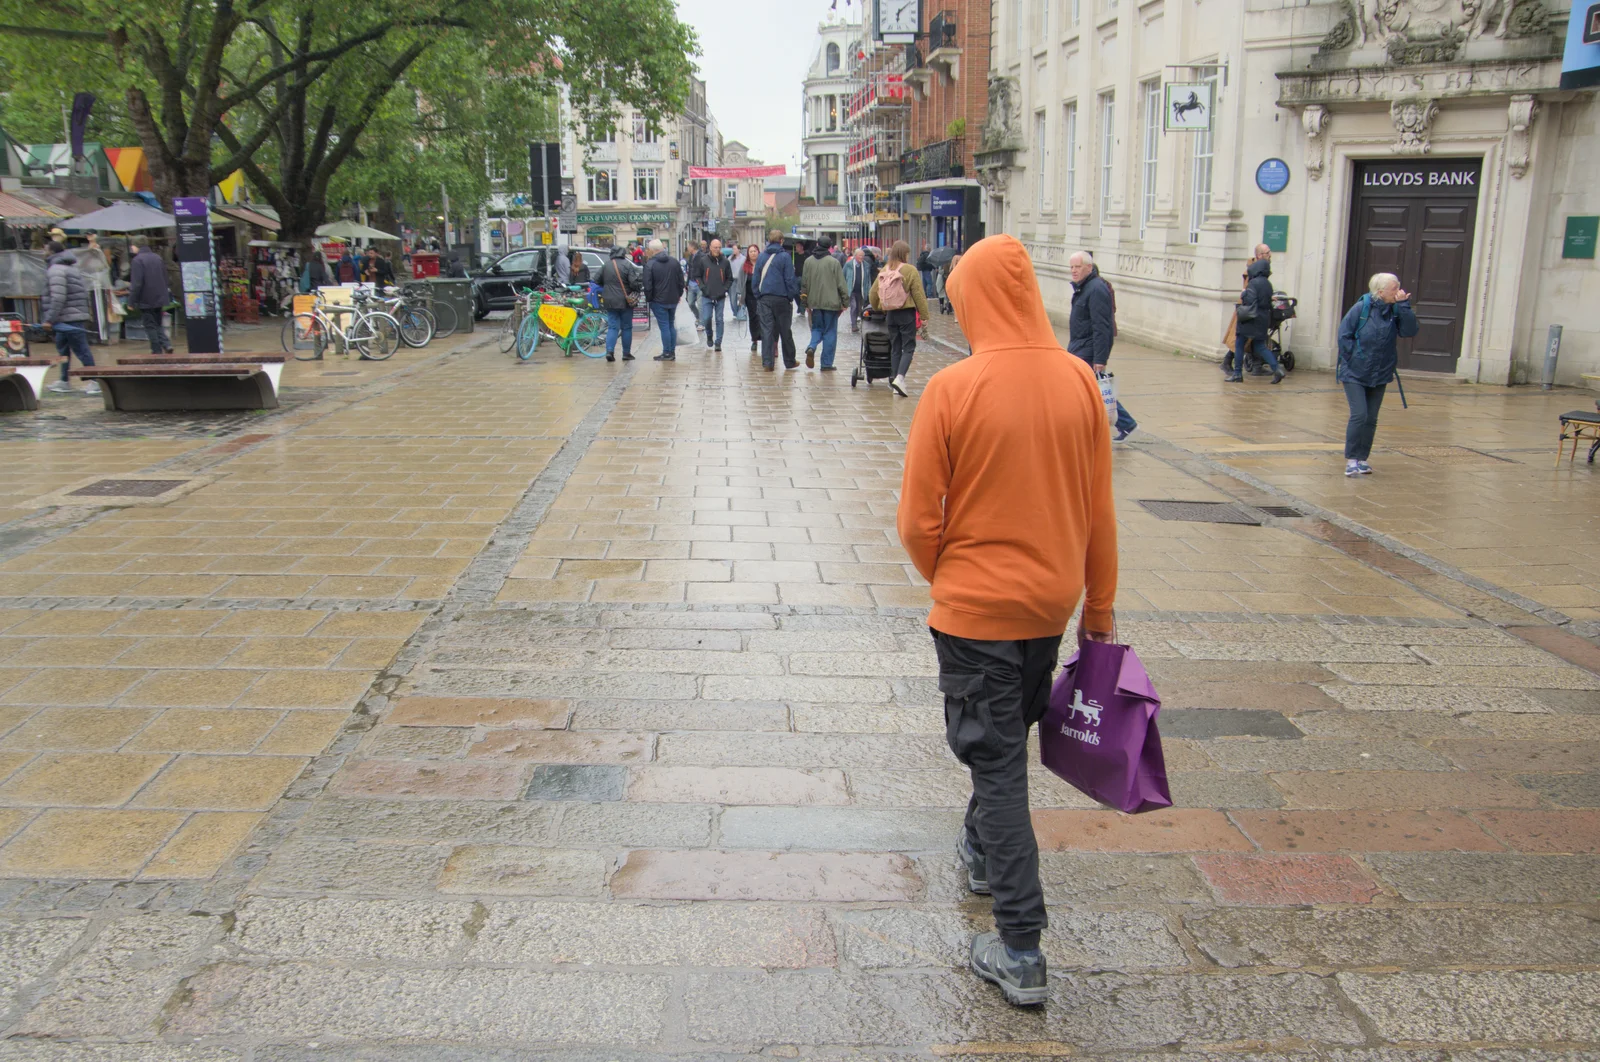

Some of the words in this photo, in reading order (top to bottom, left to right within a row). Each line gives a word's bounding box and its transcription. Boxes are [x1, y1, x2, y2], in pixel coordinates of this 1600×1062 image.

[1302, 73, 1425, 96] LLOYDS
[1442, 66, 1539, 91] BANK
[1363, 172, 1424, 186] LLOYDS
[1428, 171, 1476, 185] BANK
[600, 213, 627, 221] VAPOURS
[1060, 722, 1100, 745] Jarrolds
